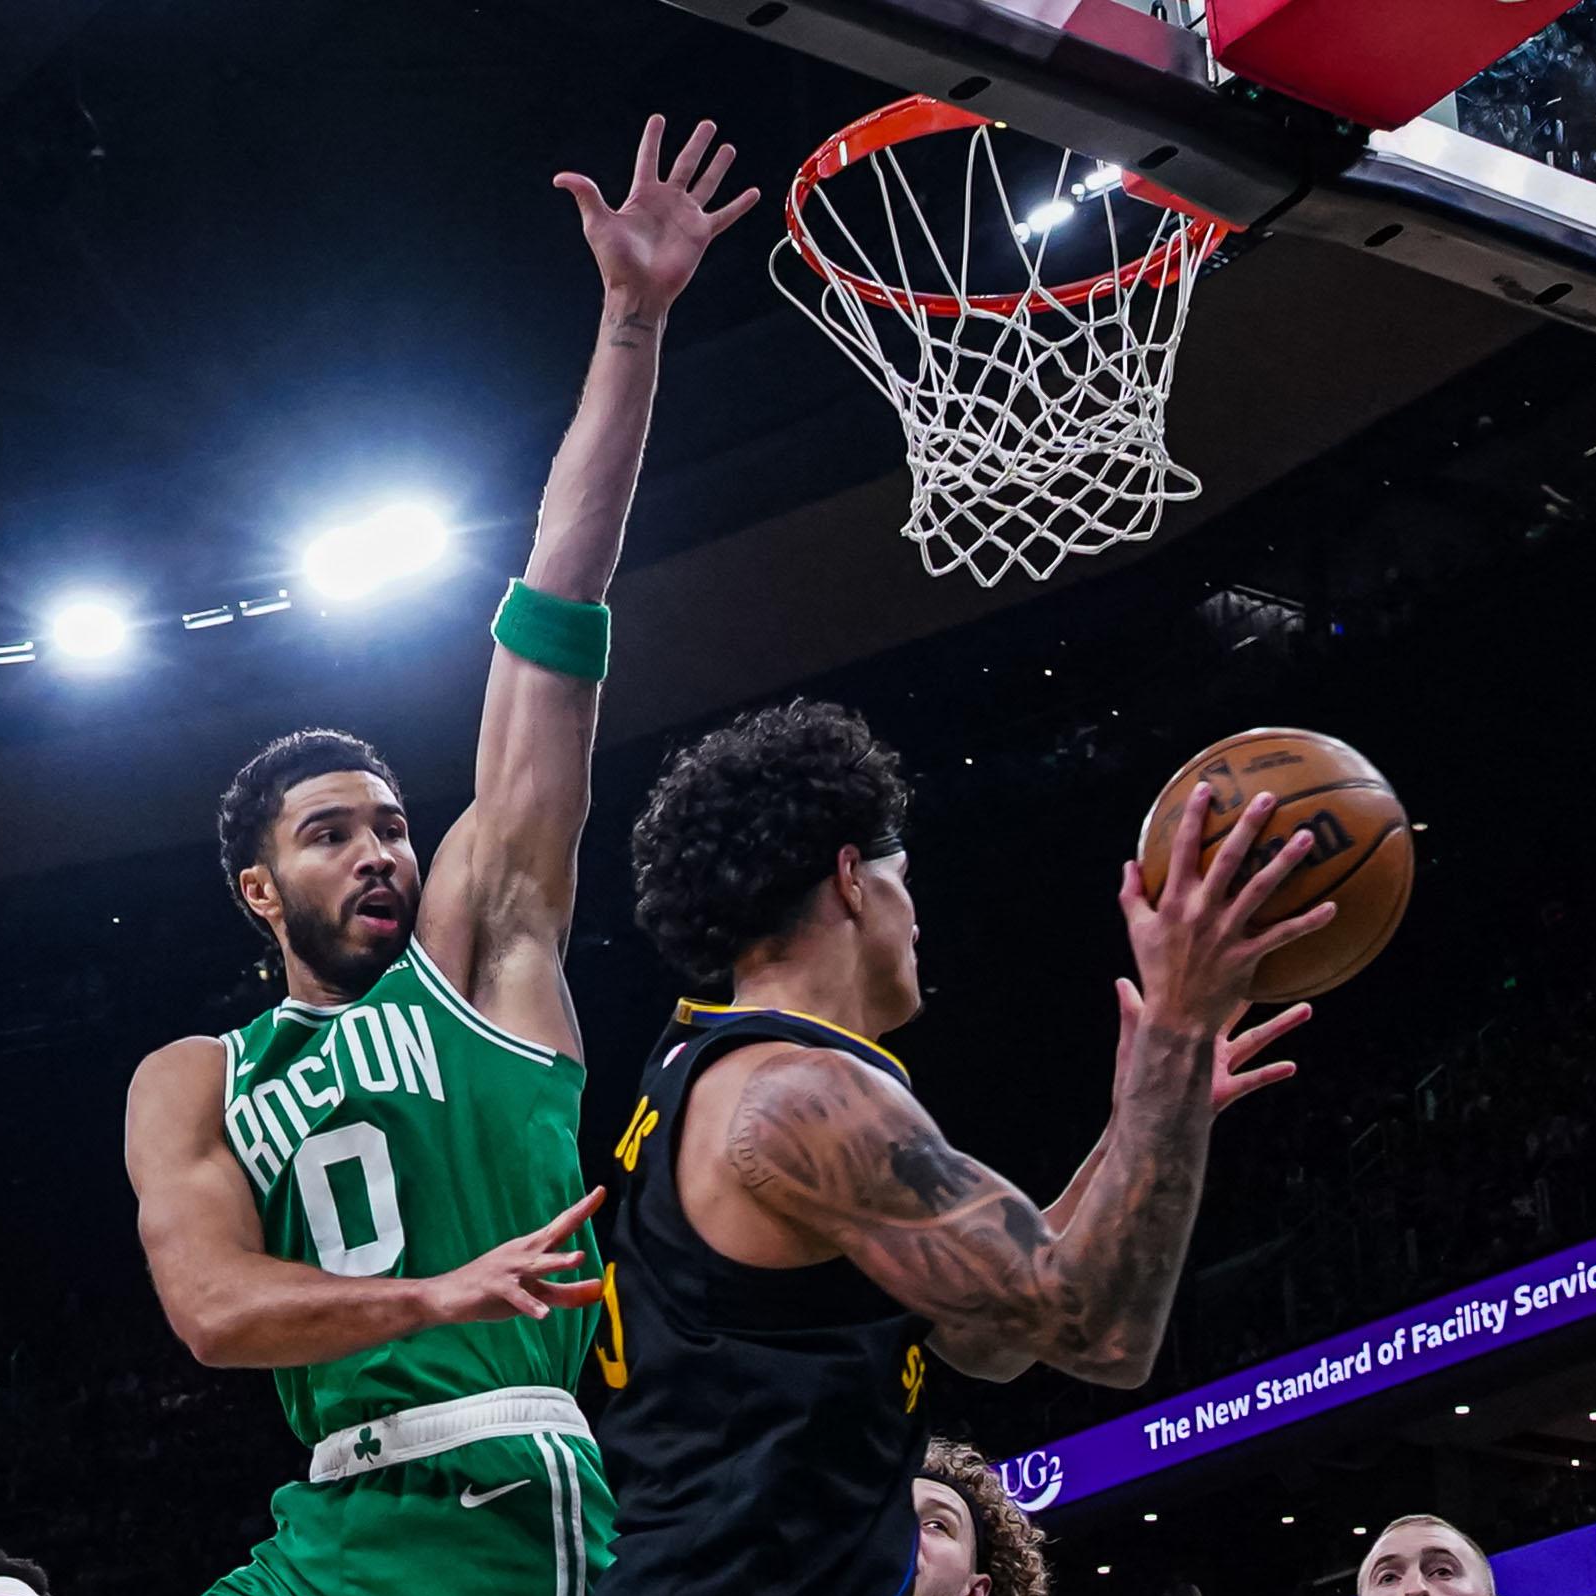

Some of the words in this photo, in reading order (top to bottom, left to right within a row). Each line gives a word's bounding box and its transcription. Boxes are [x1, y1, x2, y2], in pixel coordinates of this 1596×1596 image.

[295, 1120, 405, 1278] 0
[1144, 1417, 1190, 1450] The
[1195, 1394, 1251, 1433] New
[1256, 1342, 1372, 1410] Standard
[1377, 1328, 1406, 1365] of
[1411, 1300, 1508, 1354] Facility
[1000, 1450, 1064, 1497] UG2
